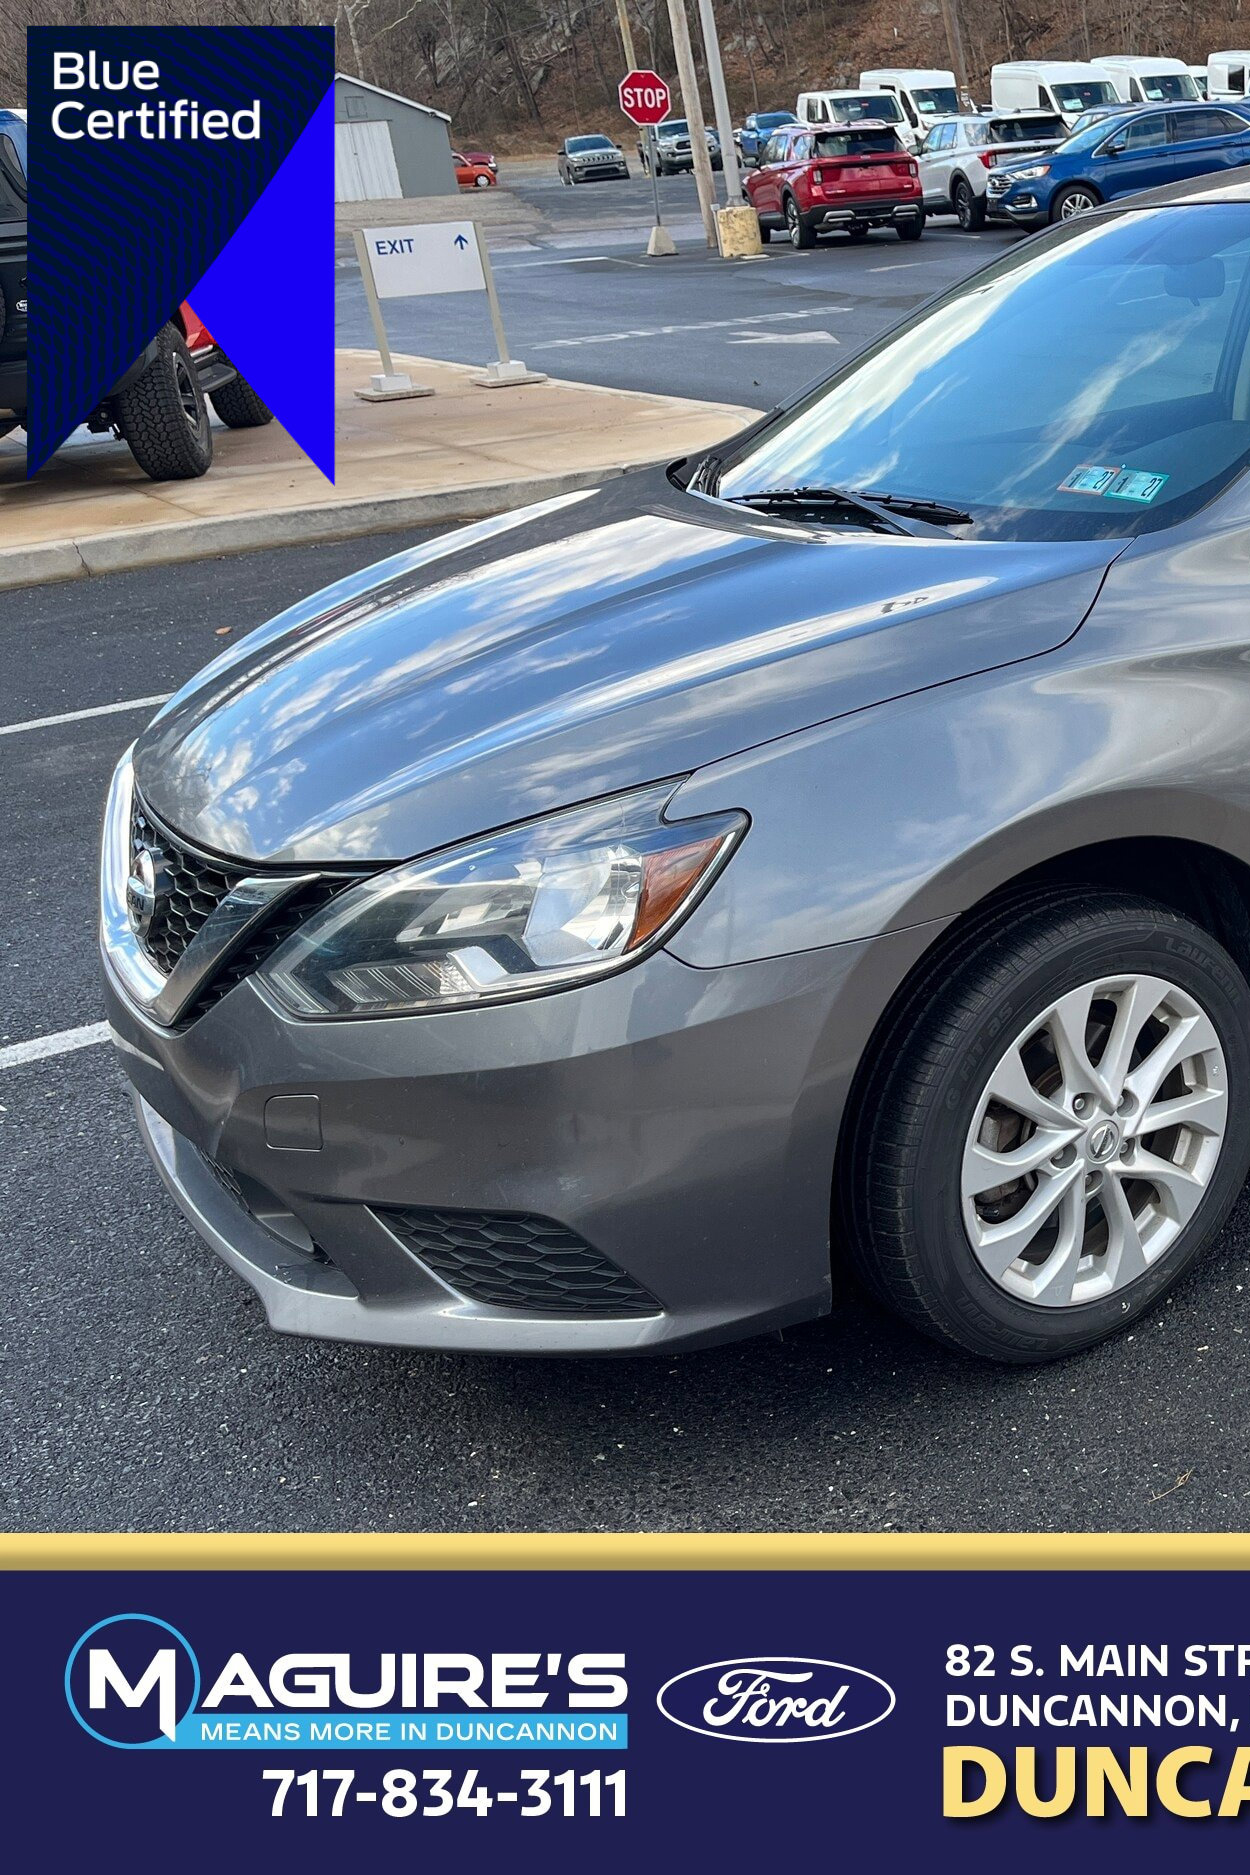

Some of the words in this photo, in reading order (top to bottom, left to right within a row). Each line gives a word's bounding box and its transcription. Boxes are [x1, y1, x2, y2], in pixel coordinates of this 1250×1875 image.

[623, 87, 666, 108] STOP
[375, 238, 414, 256] EXIT
[1093, 470, 1115, 491] 27
[1141, 477, 1163, 498] 27
